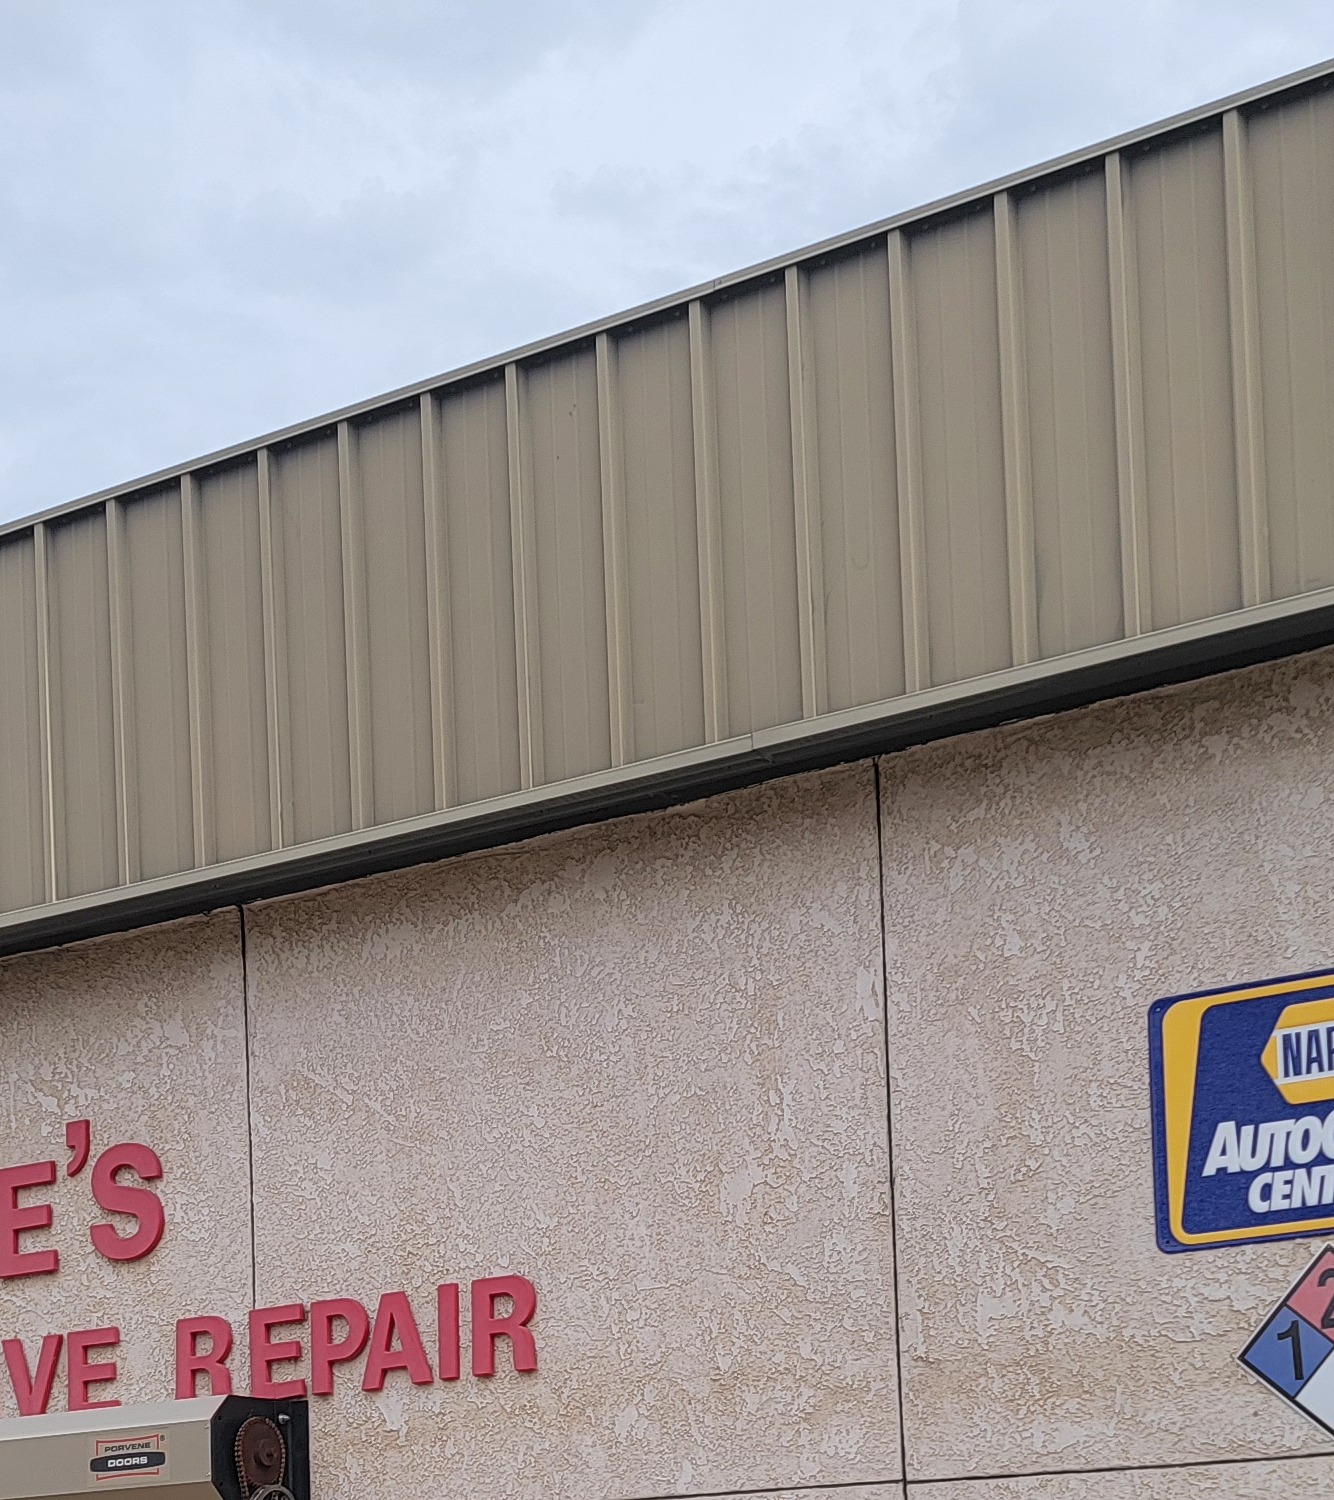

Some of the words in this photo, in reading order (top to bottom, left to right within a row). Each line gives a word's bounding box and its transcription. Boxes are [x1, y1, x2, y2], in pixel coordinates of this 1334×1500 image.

[174, 1274, 539, 1400] REPAIR
[1276, 1319, 1305, 1382] 1
[104, 1442, 152, 1453] PORVENE
[107, 1456, 148, 1468] DOORS
